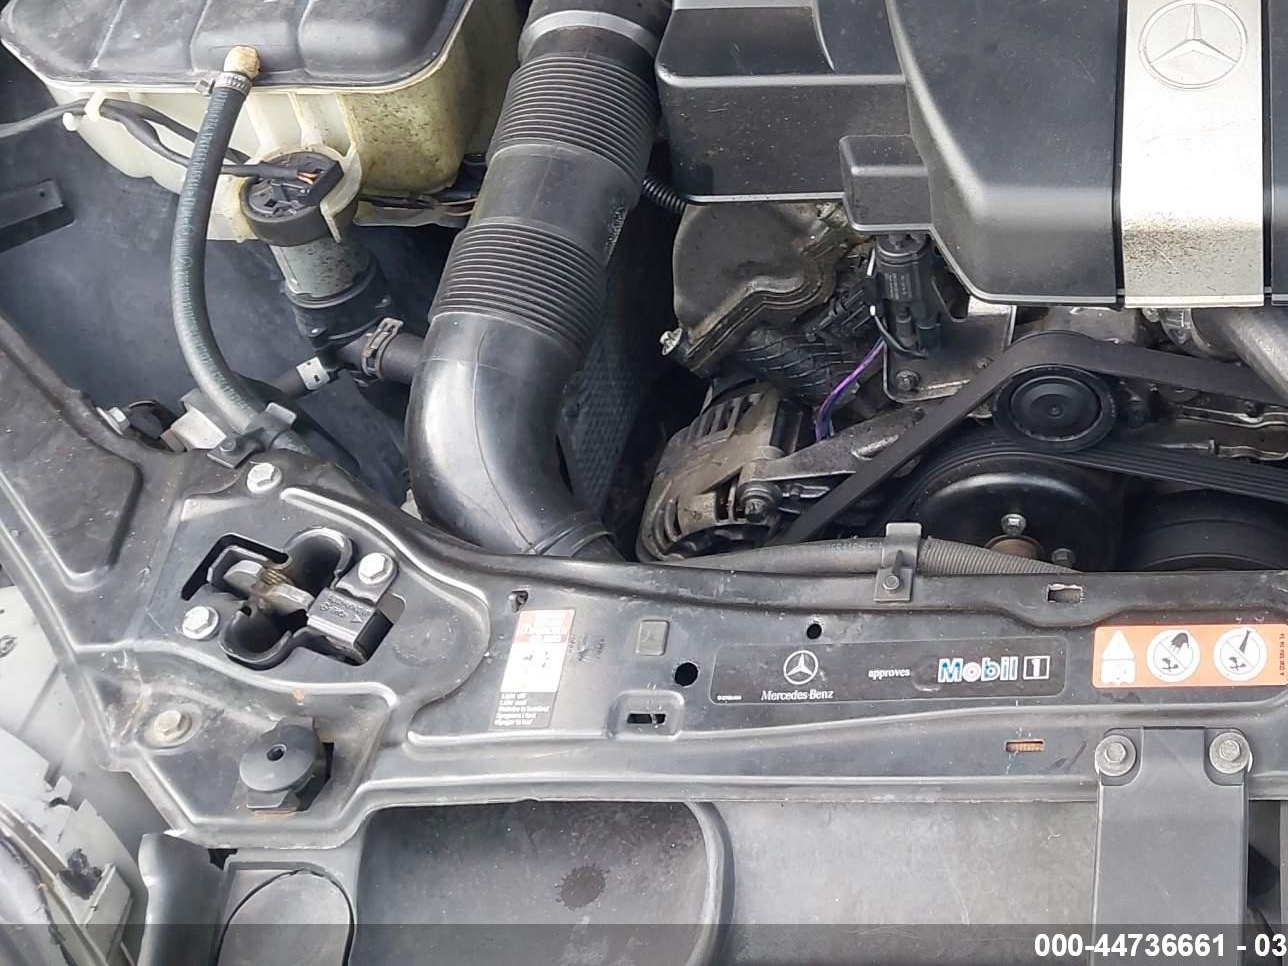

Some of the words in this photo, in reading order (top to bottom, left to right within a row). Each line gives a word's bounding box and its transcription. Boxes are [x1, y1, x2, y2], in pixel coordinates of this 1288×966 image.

[868, 667, 911, 679] approves
[937, 657, 1019, 683] Mobil
[761, 689, 834, 701] Mercedes-Benz
